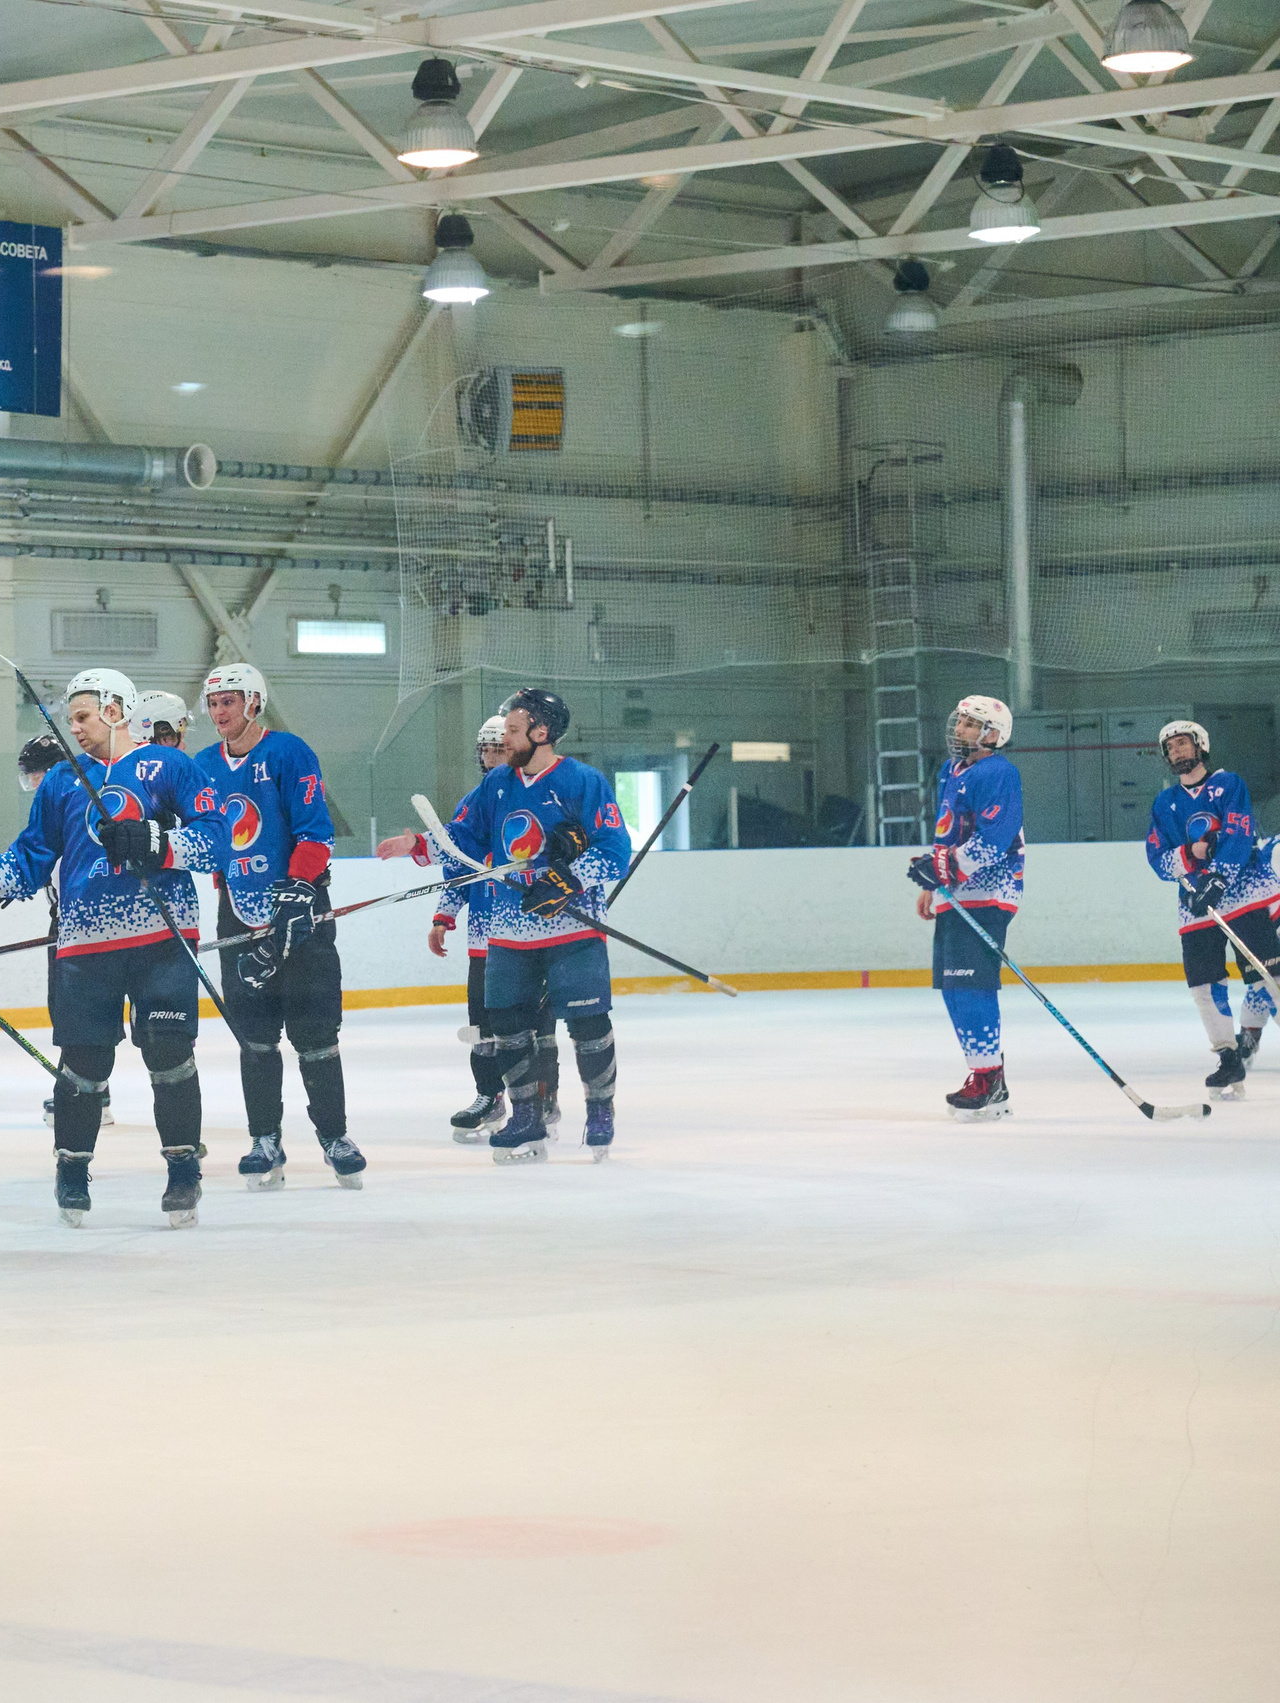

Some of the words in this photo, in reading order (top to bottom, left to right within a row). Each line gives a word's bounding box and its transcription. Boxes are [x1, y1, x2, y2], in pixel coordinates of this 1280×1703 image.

[135, 760, 162, 781] 67
[252, 761, 271, 783] 71
[147, 819, 161, 854] RIME
[938, 848, 948, 879] UER
[148, 1010, 187, 1021] PRIME
